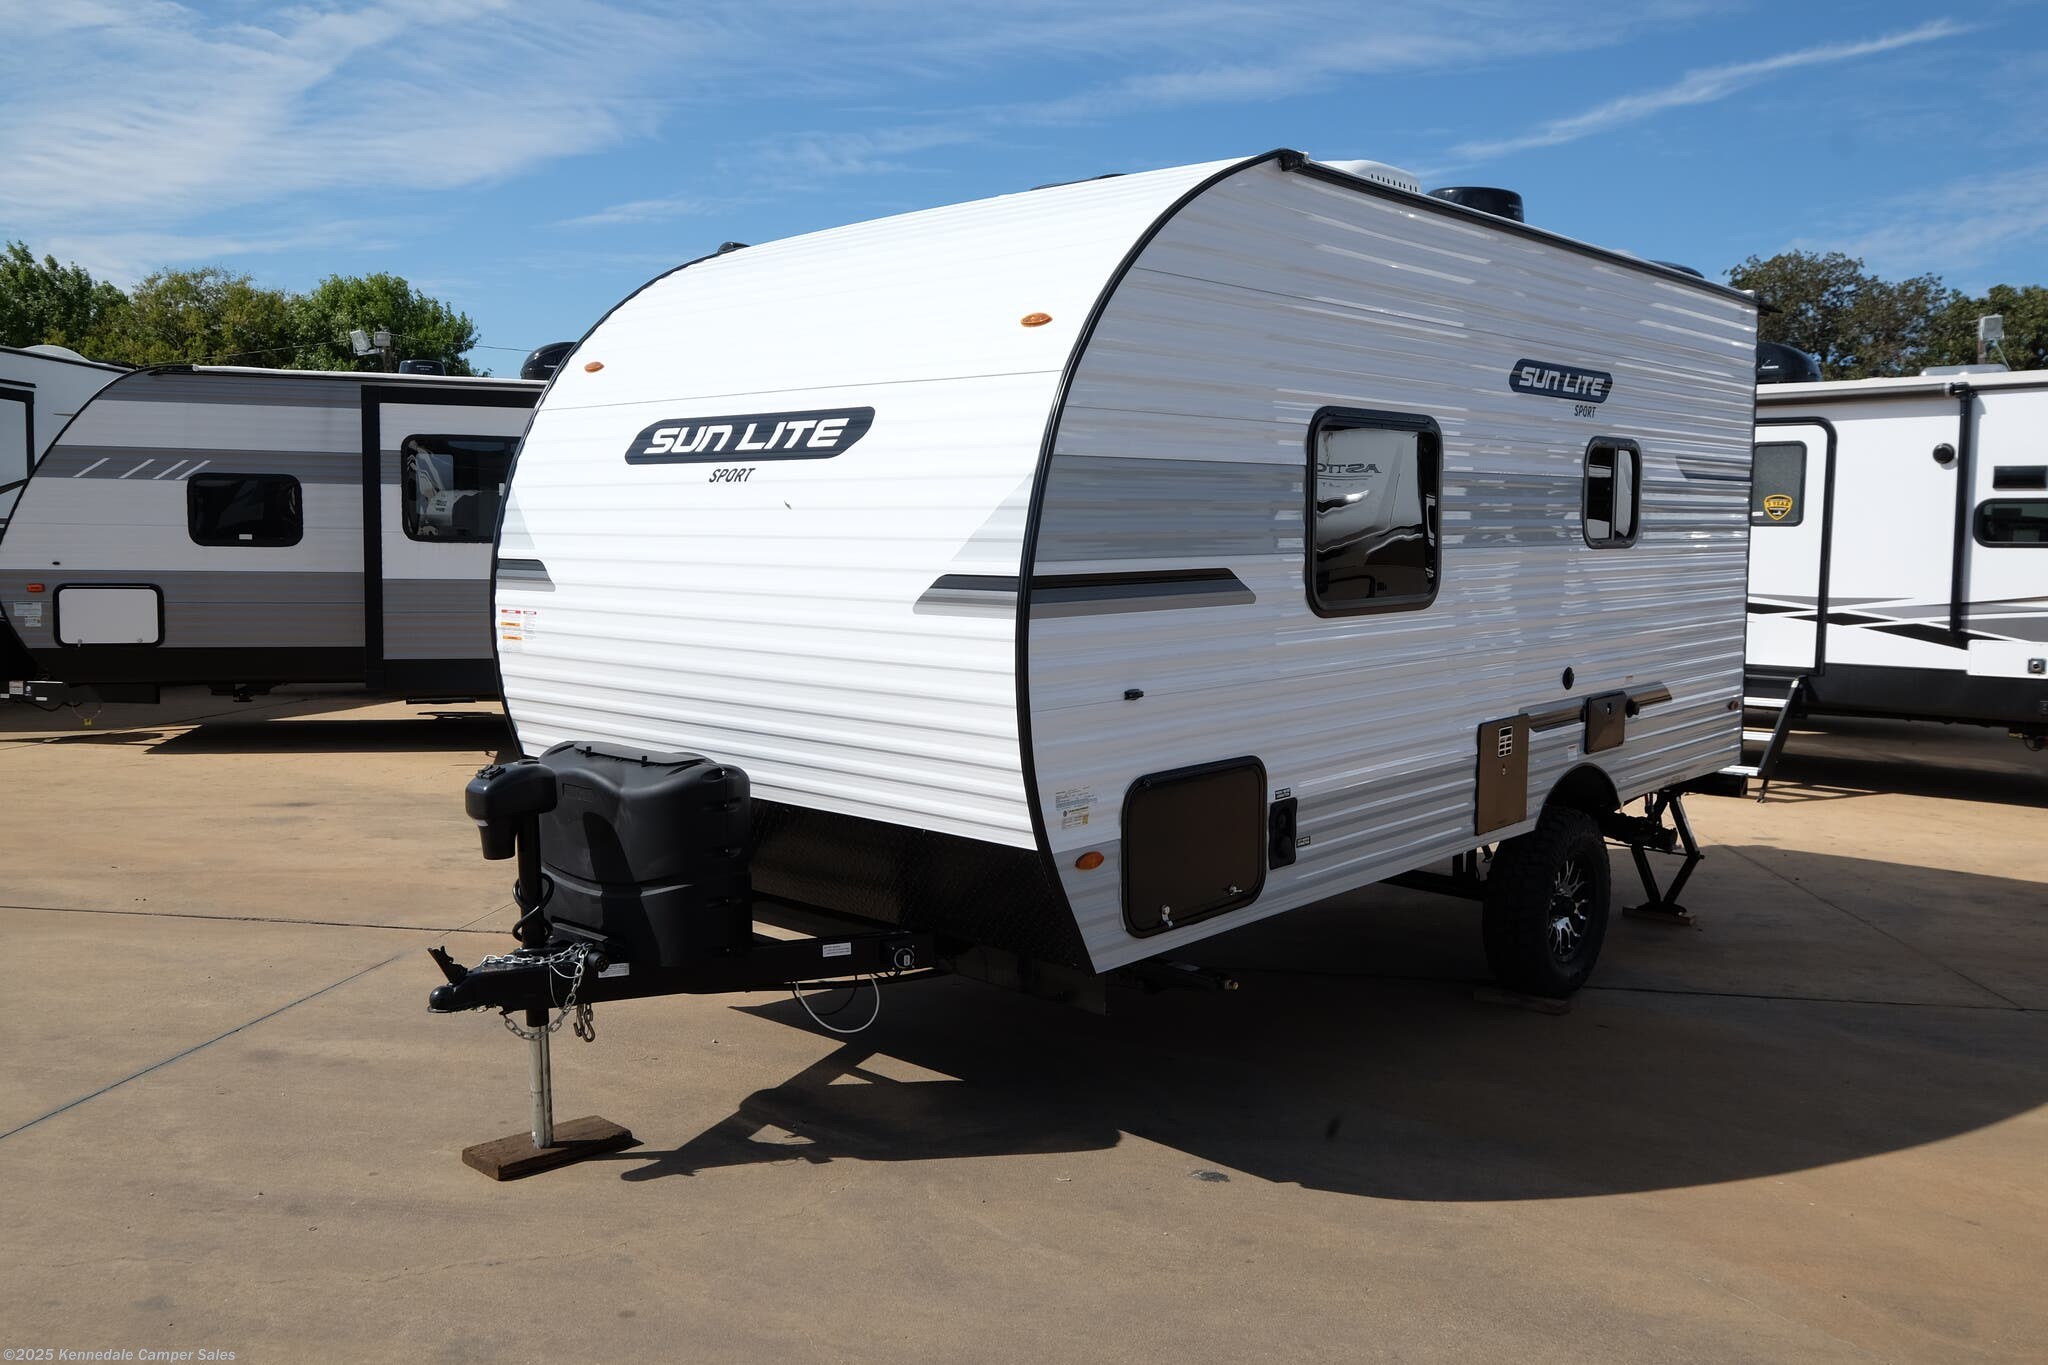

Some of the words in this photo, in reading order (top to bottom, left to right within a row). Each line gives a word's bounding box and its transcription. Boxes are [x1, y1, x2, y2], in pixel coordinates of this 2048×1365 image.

[1519, 366, 1560, 390] SUN
[1563, 373, 1605, 396] LITE
[1574, 404, 1597, 418] SPORT
[643, 424, 733, 454] SUN
[735, 417, 850, 451] LITE
[708, 467, 756, 483] SPORT
